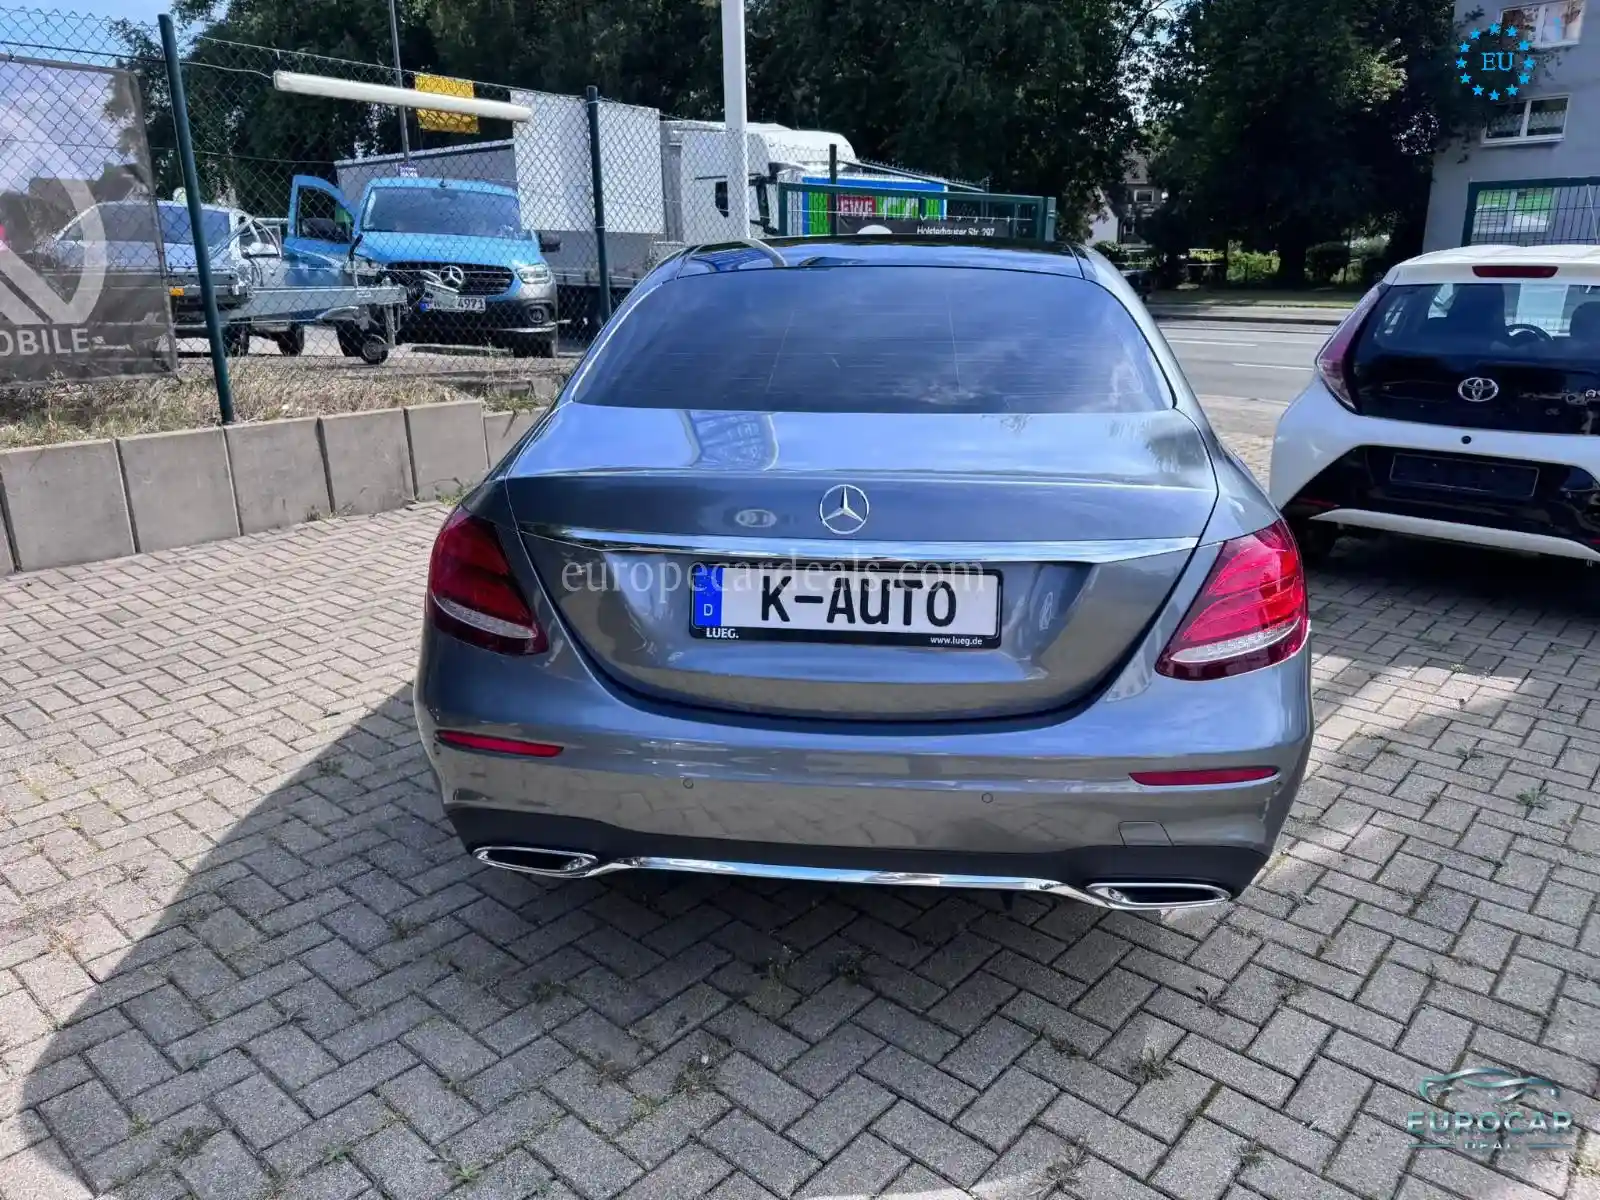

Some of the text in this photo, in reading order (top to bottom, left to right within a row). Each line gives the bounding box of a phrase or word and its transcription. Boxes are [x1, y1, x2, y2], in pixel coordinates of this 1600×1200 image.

[761, 575, 957, 628] K-AUTO
[703, 603, 713, 616] D
[930, 635, 983, 646] www.lueg.de
